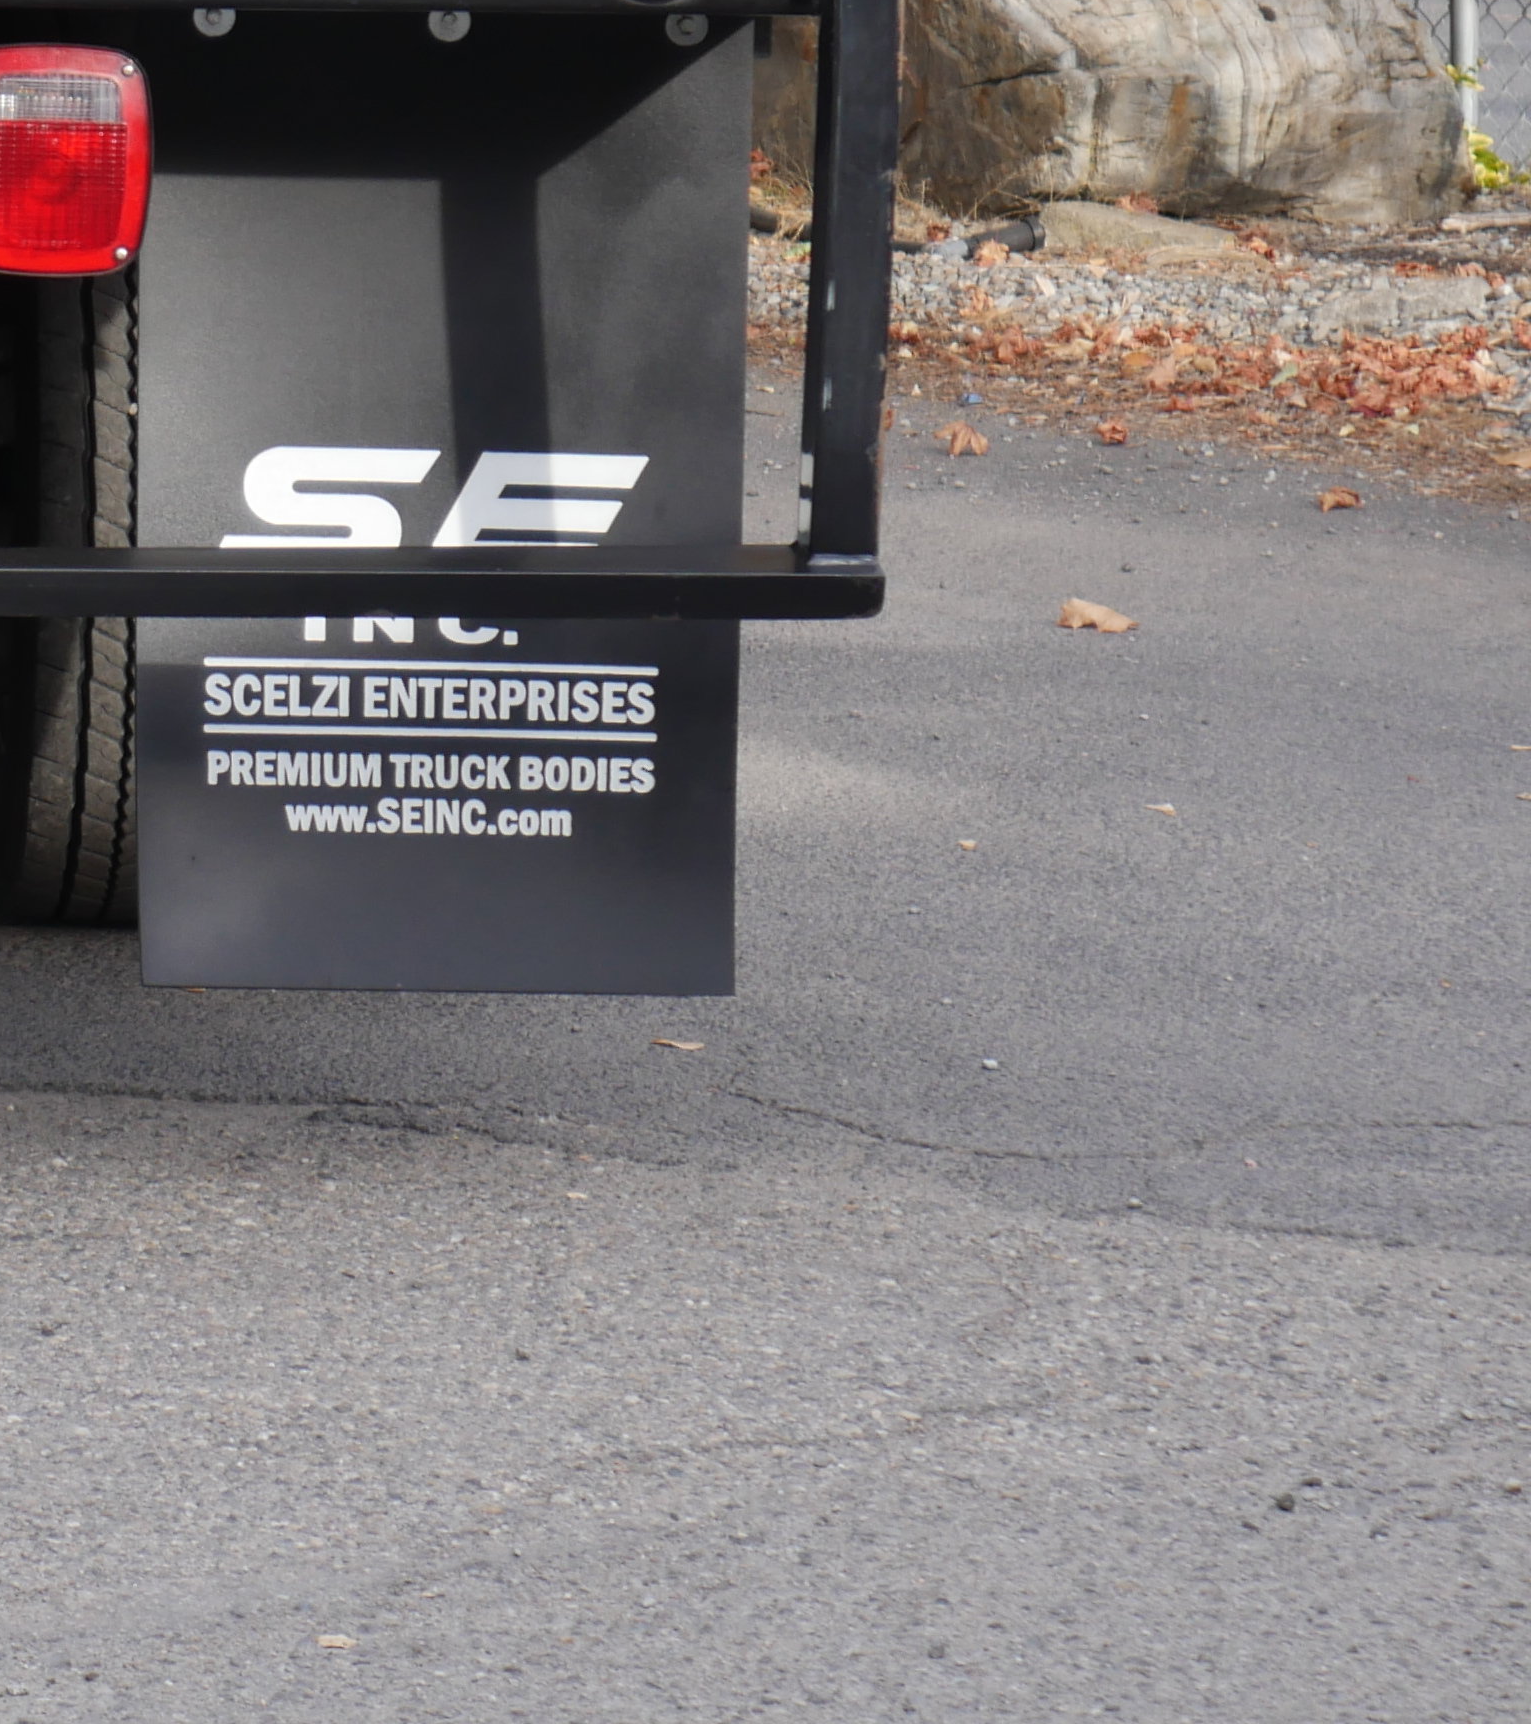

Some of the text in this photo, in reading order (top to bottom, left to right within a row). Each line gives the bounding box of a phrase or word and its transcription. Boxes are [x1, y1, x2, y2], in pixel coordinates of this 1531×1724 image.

[219, 446, 650, 548] SE
[203, 672, 657, 725] SCELZI ENTERPRISES
[207, 750, 657, 793] PREMIUM TRUCK BODIES
[285, 797, 573, 837] www.SEINC.com
